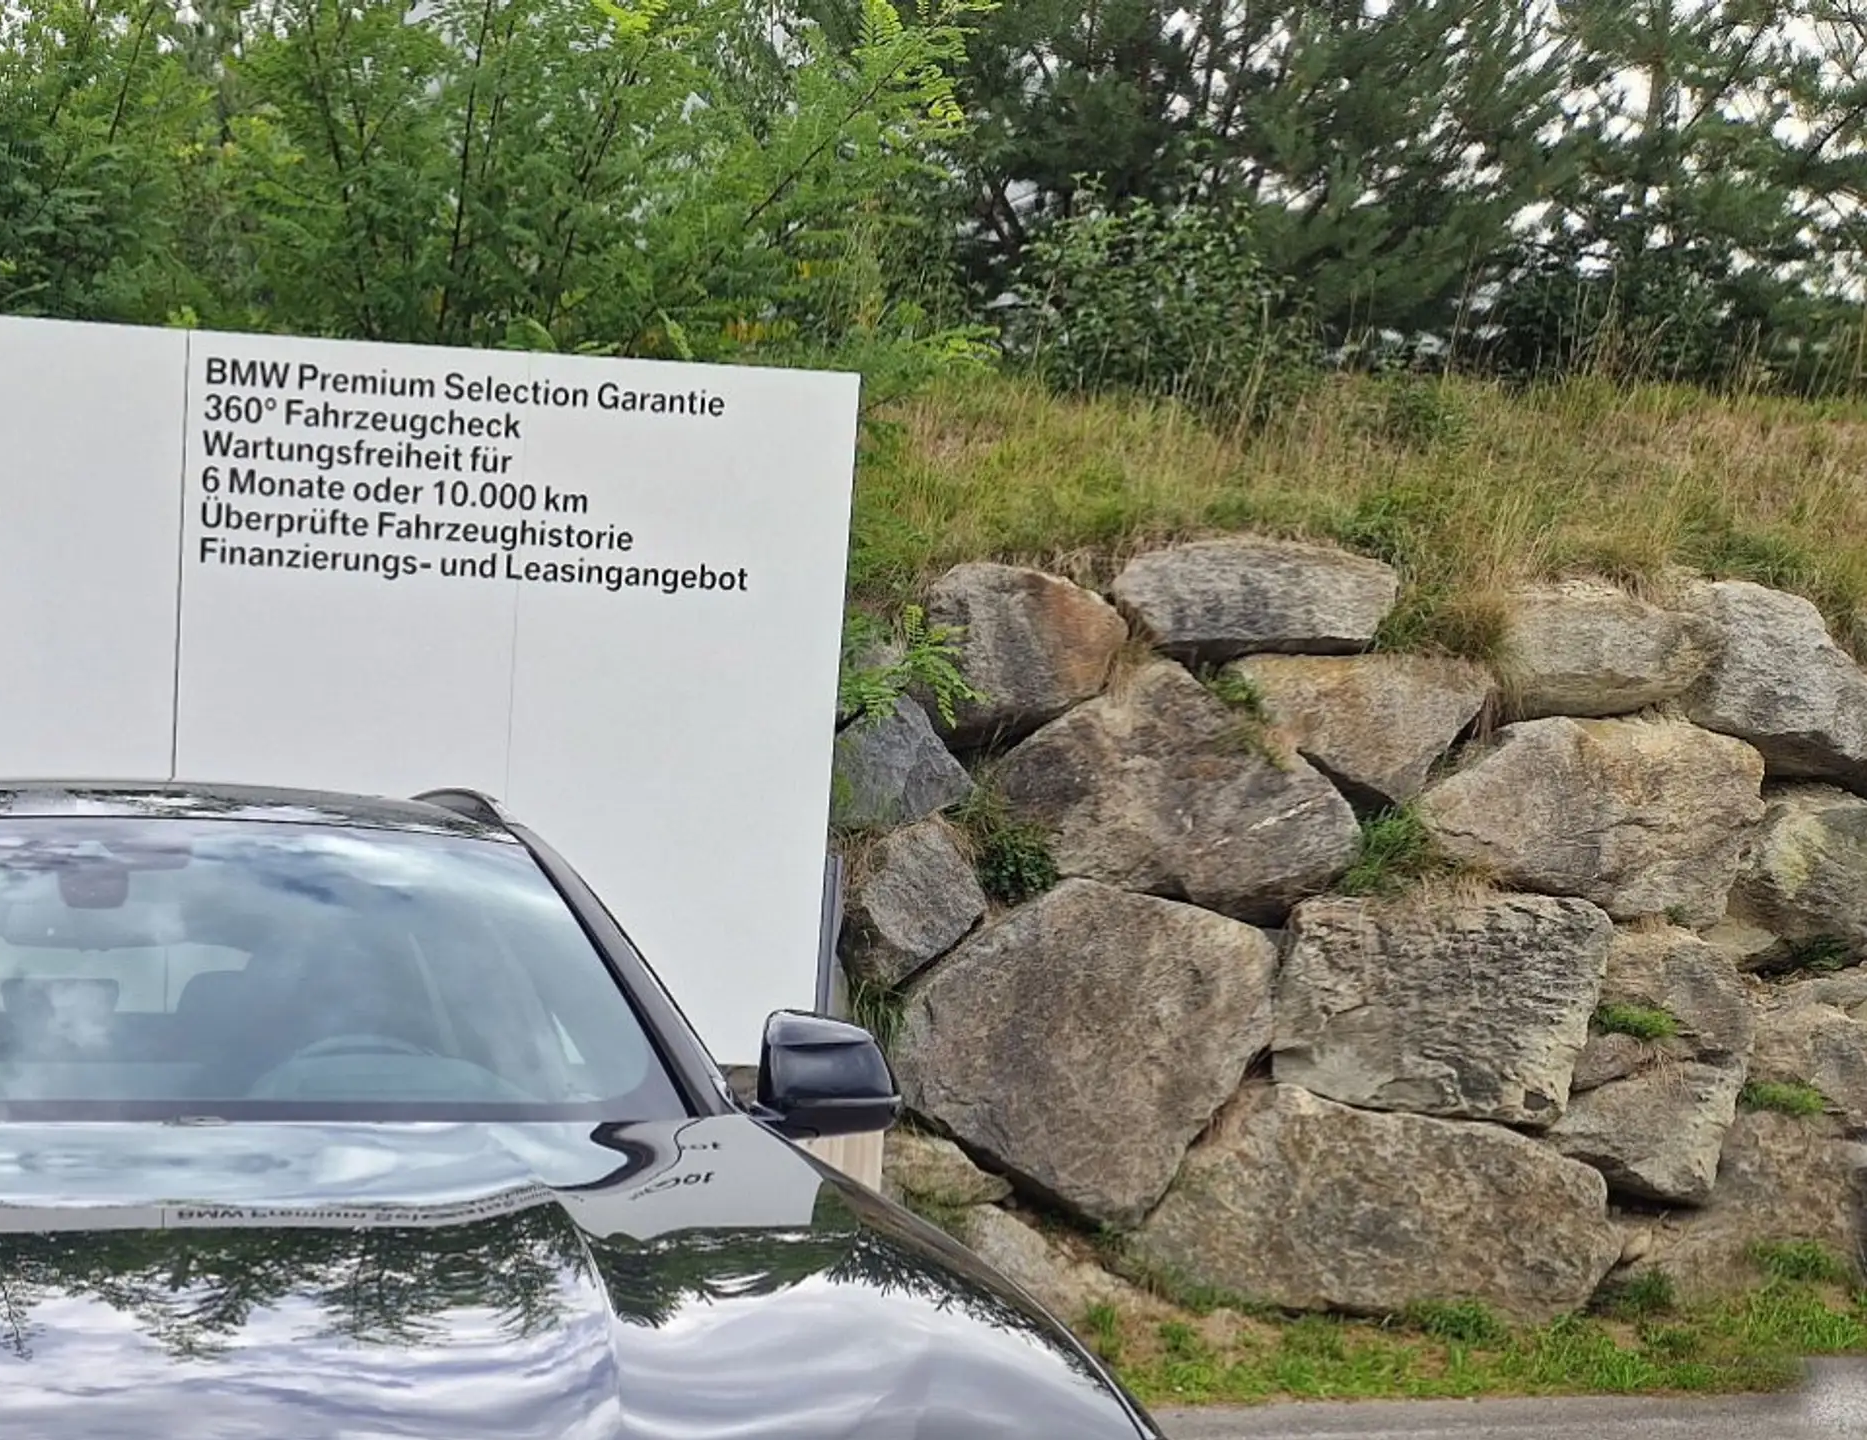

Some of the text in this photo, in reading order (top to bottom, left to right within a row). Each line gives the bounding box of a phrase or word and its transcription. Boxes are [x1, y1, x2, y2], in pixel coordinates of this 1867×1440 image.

[206, 357, 725, 417] BMW Premium Selection Garantie
[204, 394, 520, 440] 360° Fahrzeugcheck
[203, 430, 512, 474] Wartungsfreiheit für
[202, 466, 588, 514] 6 Monate oder 10.000 km
[201, 496, 633, 552] Überprüfte Fahrzeughistorie
[200, 537, 748, 594] Finanzierungs- und Leasingangebot
